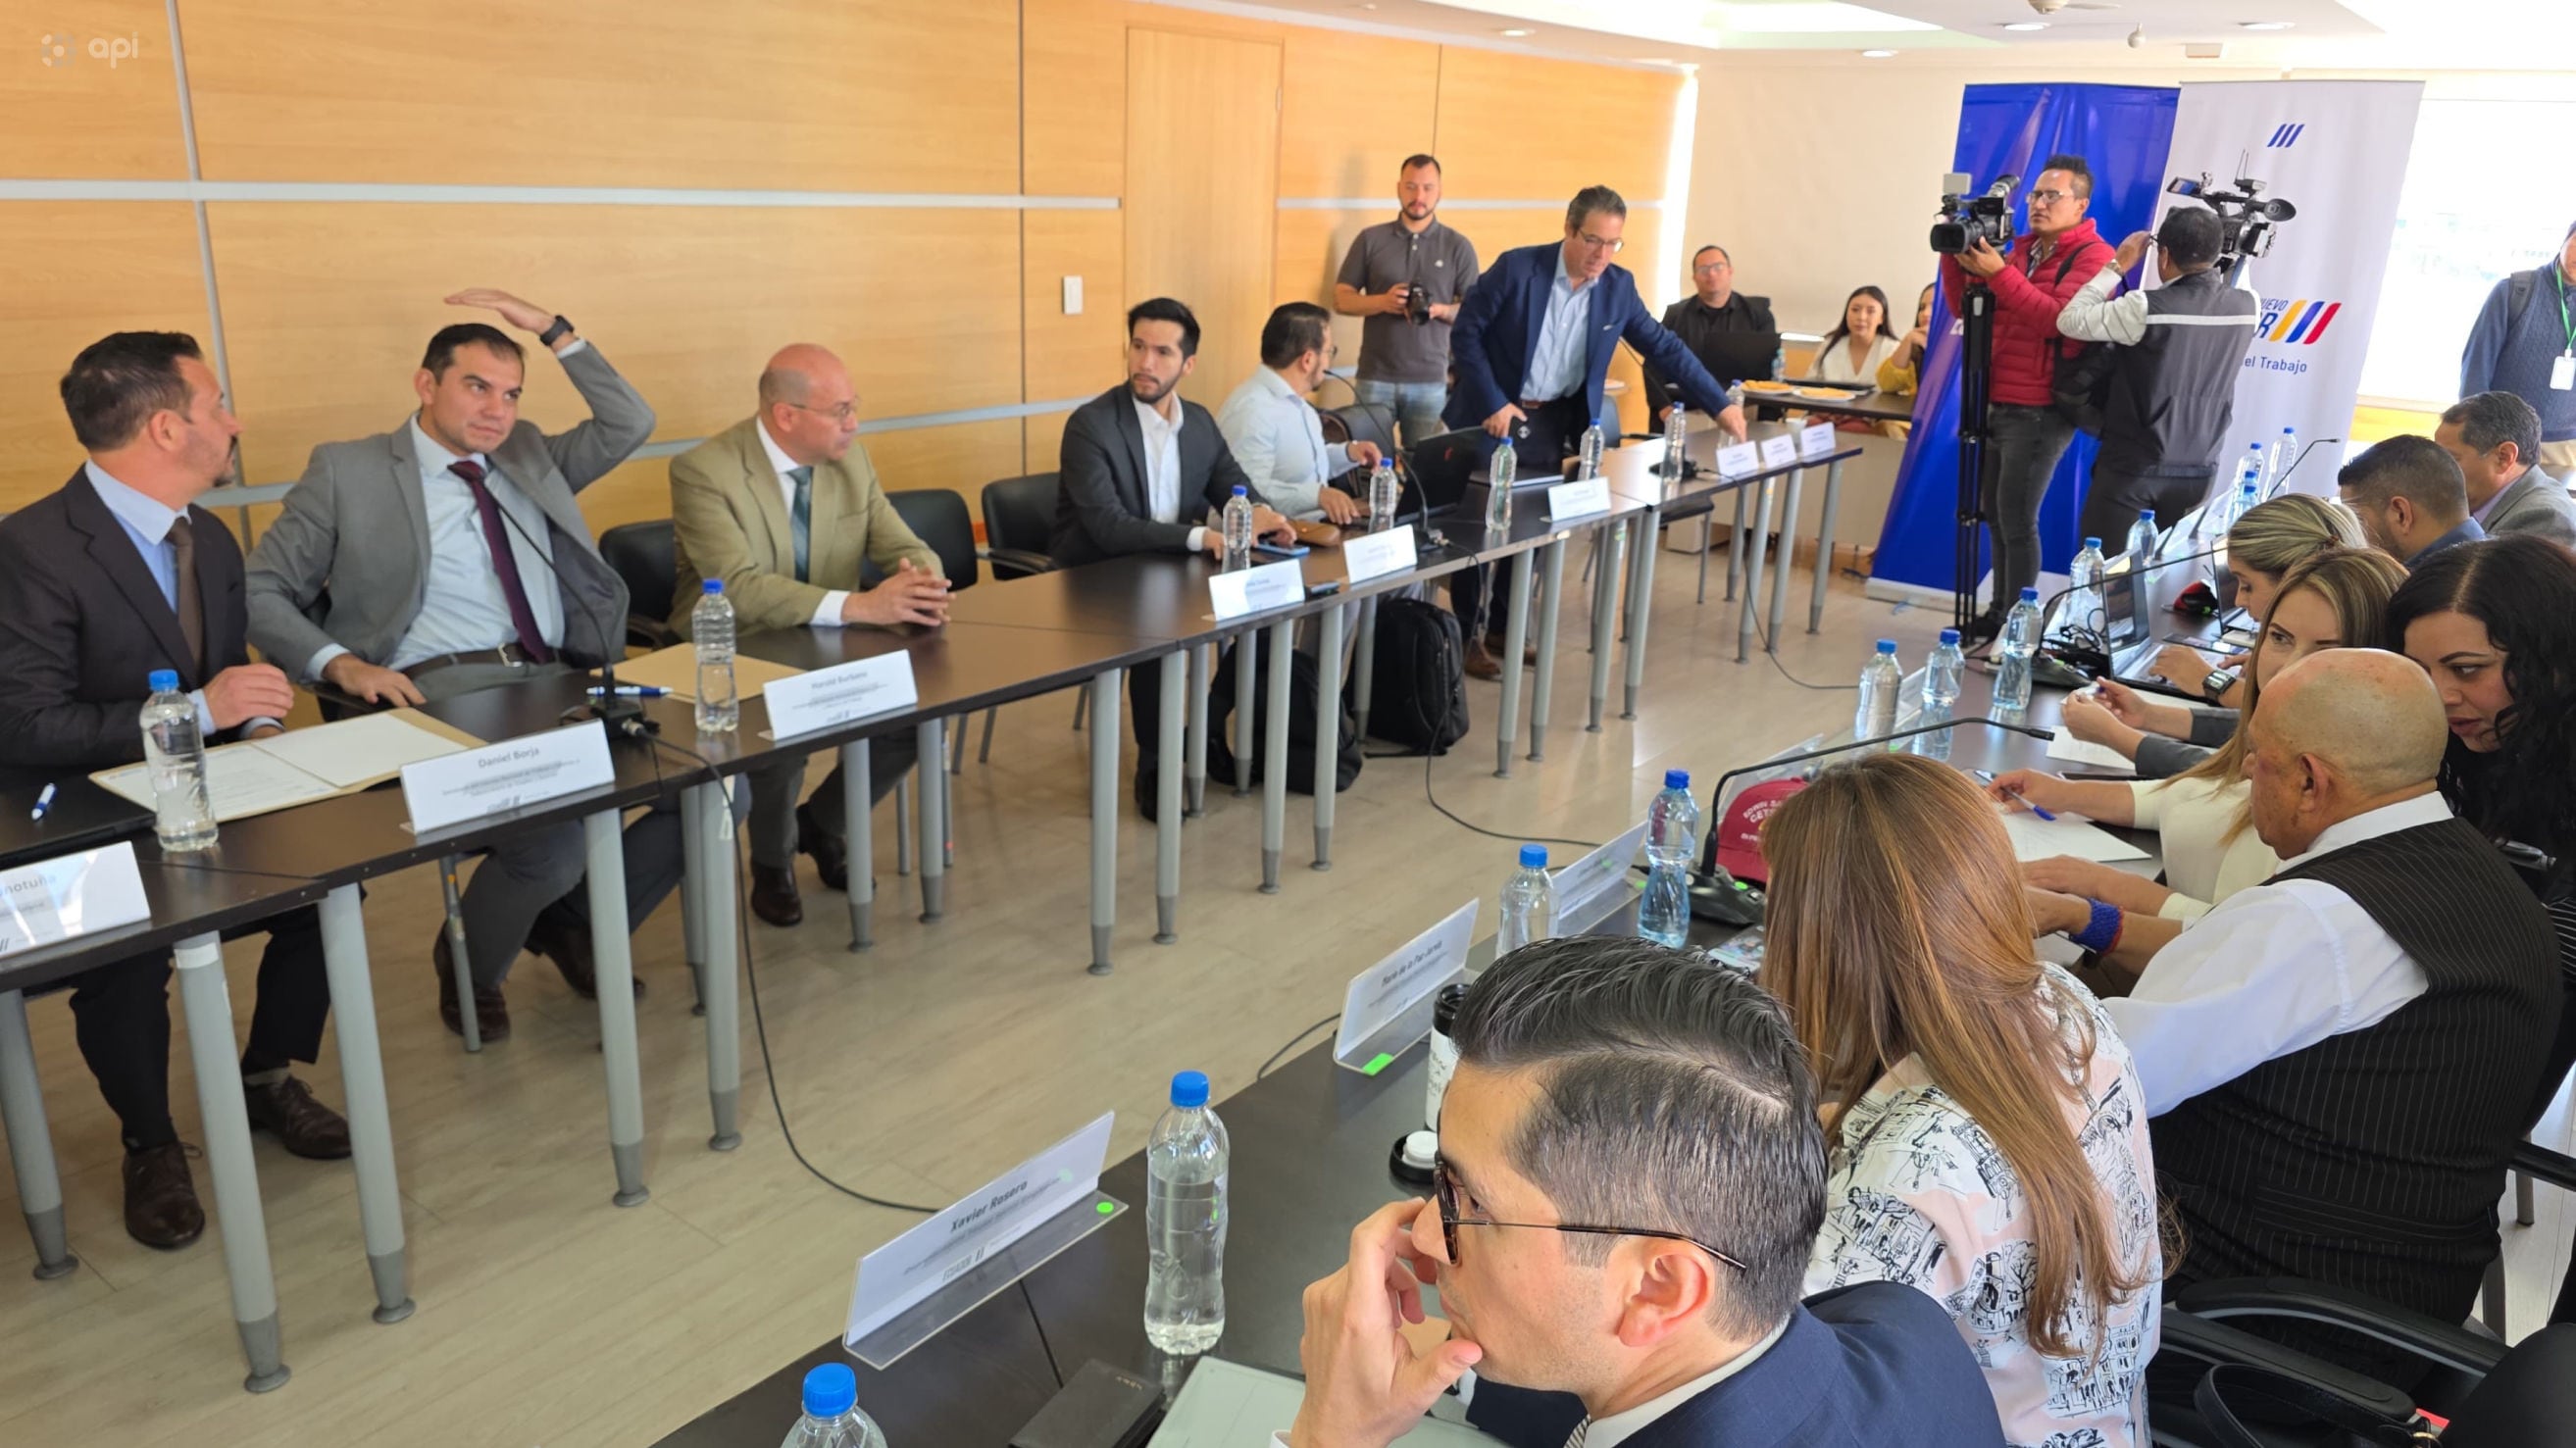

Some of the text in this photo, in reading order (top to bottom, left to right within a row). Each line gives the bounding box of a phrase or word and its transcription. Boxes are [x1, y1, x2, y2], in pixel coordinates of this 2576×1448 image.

[2260, 298, 2289, 311] UEVO
[2260, 356, 2307, 374] Trabajo
[478, 746, 540, 769] Daniel Borja
[950, 1180, 1028, 1232] Xavier Rosero
